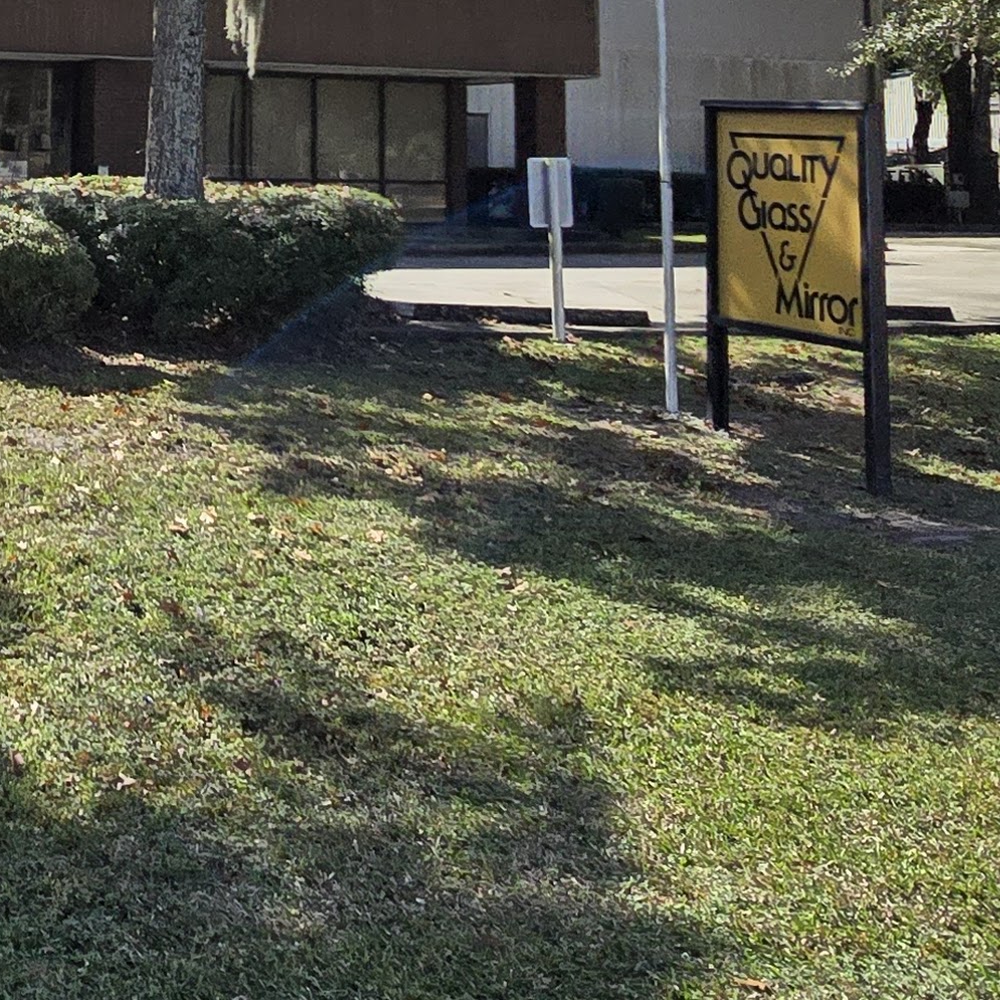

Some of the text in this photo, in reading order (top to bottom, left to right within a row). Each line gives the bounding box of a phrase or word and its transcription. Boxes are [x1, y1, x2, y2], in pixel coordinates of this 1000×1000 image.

[738, 190, 813, 233] Glass
[779, 240, 797, 272] &
[775, 278, 858, 327] Mirror
